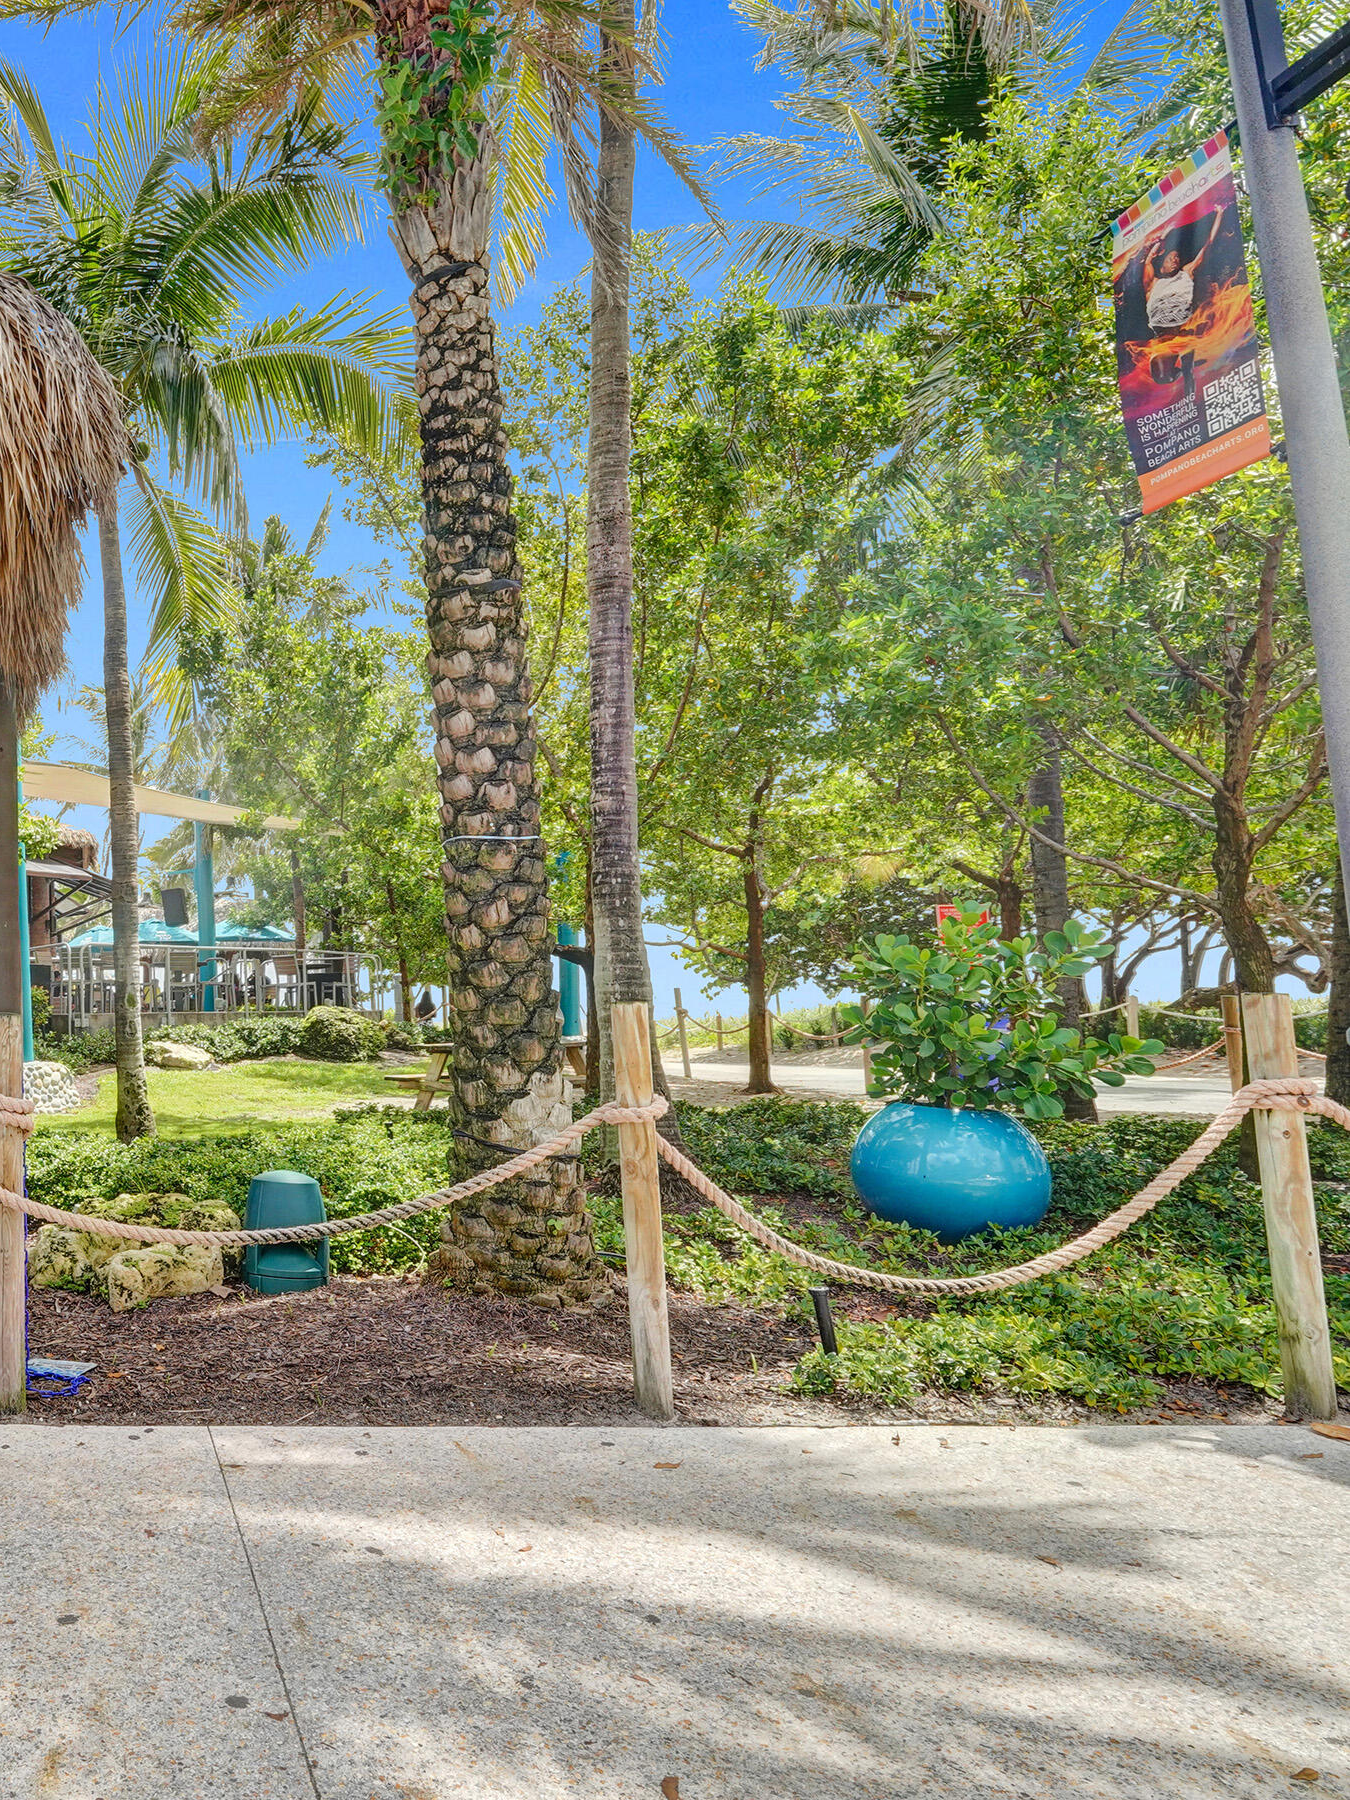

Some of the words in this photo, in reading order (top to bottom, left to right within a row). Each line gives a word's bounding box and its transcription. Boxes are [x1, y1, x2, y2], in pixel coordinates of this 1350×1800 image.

[1136, 392, 1196, 427] SOMETHING
[1138, 402, 1197, 434] WONDERFUL
[1141, 434, 1151, 442] IS
[1153, 409, 1198, 437] HAPPENING
[1145, 423, 1200, 458] POMPANO
[1148, 449, 1177, 468] BEACH
[1178, 435, 1202, 452] ARTS
[1150, 424, 1264, 486] POMPANOBEACHARTS.ORG
